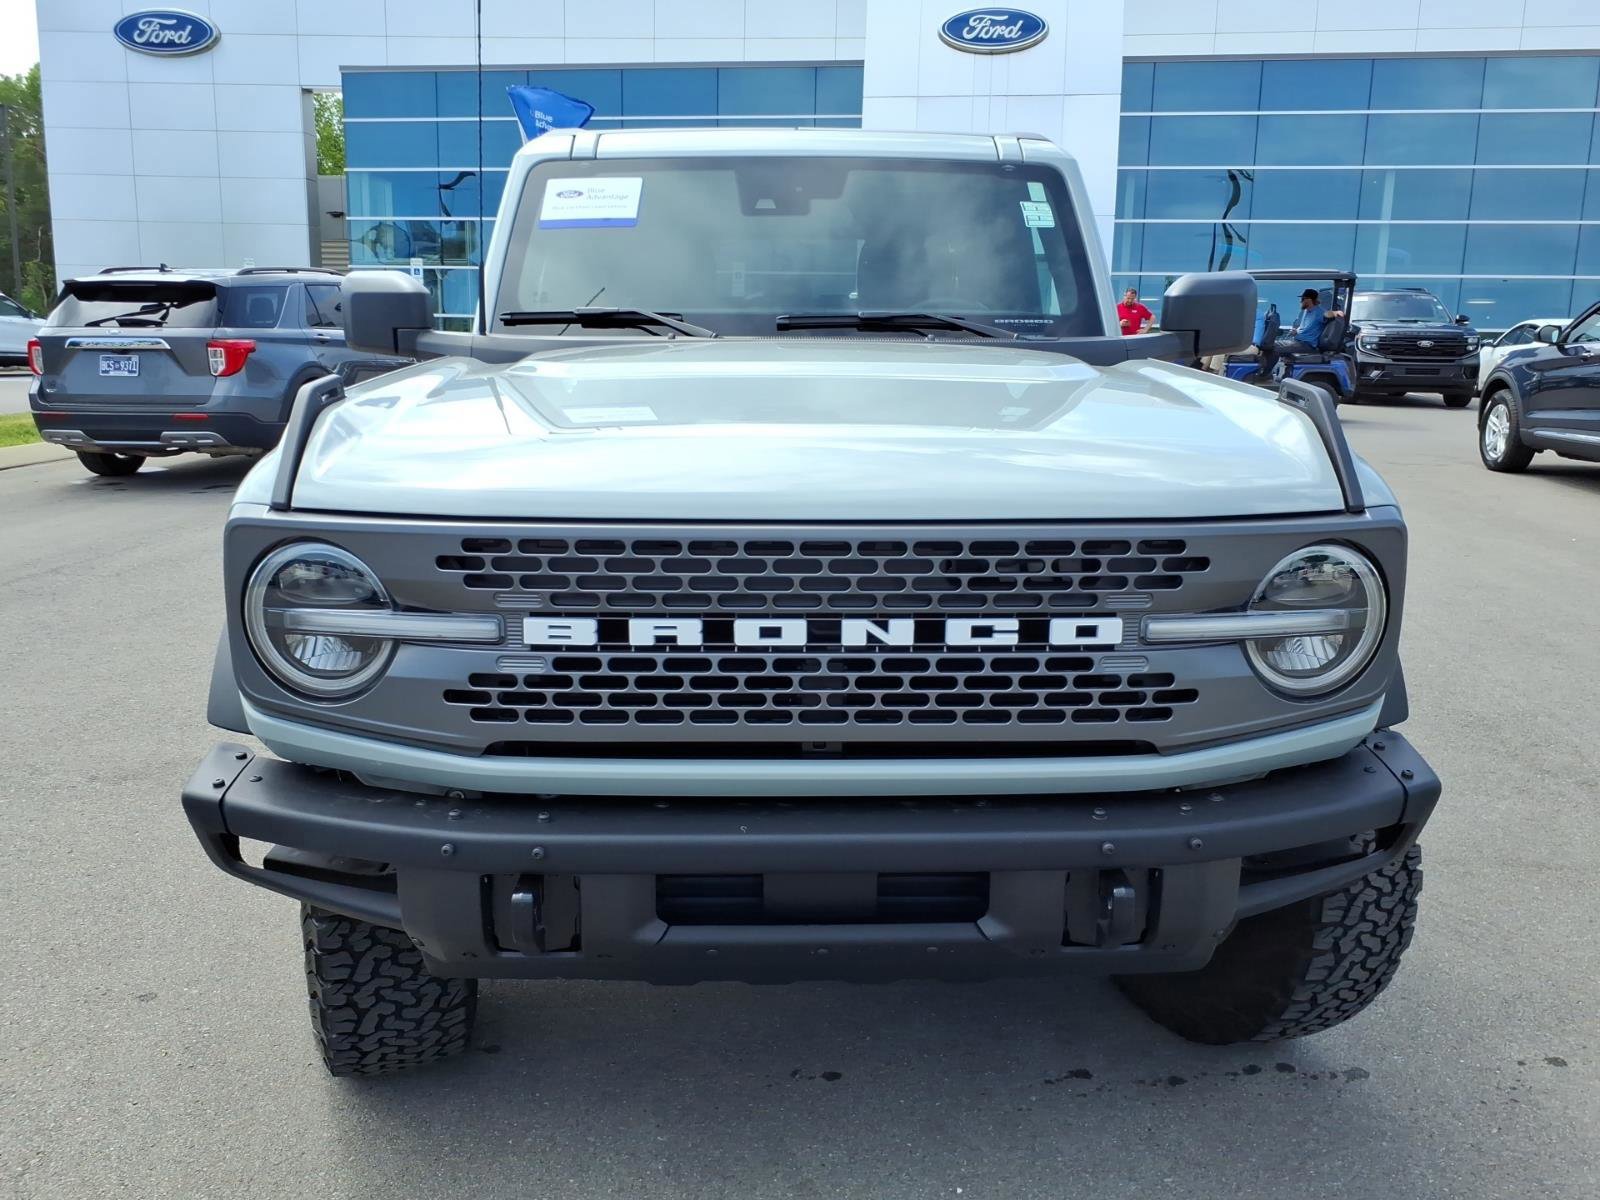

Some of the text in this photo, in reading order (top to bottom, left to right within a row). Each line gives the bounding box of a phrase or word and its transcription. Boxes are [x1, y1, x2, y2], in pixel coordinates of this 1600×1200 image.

[133, 18, 192, 44] Ford
[962, 14, 1024, 39] Ford
[534, 110, 553, 123] Blue
[523, 616, 1123, 646] BRONCO
